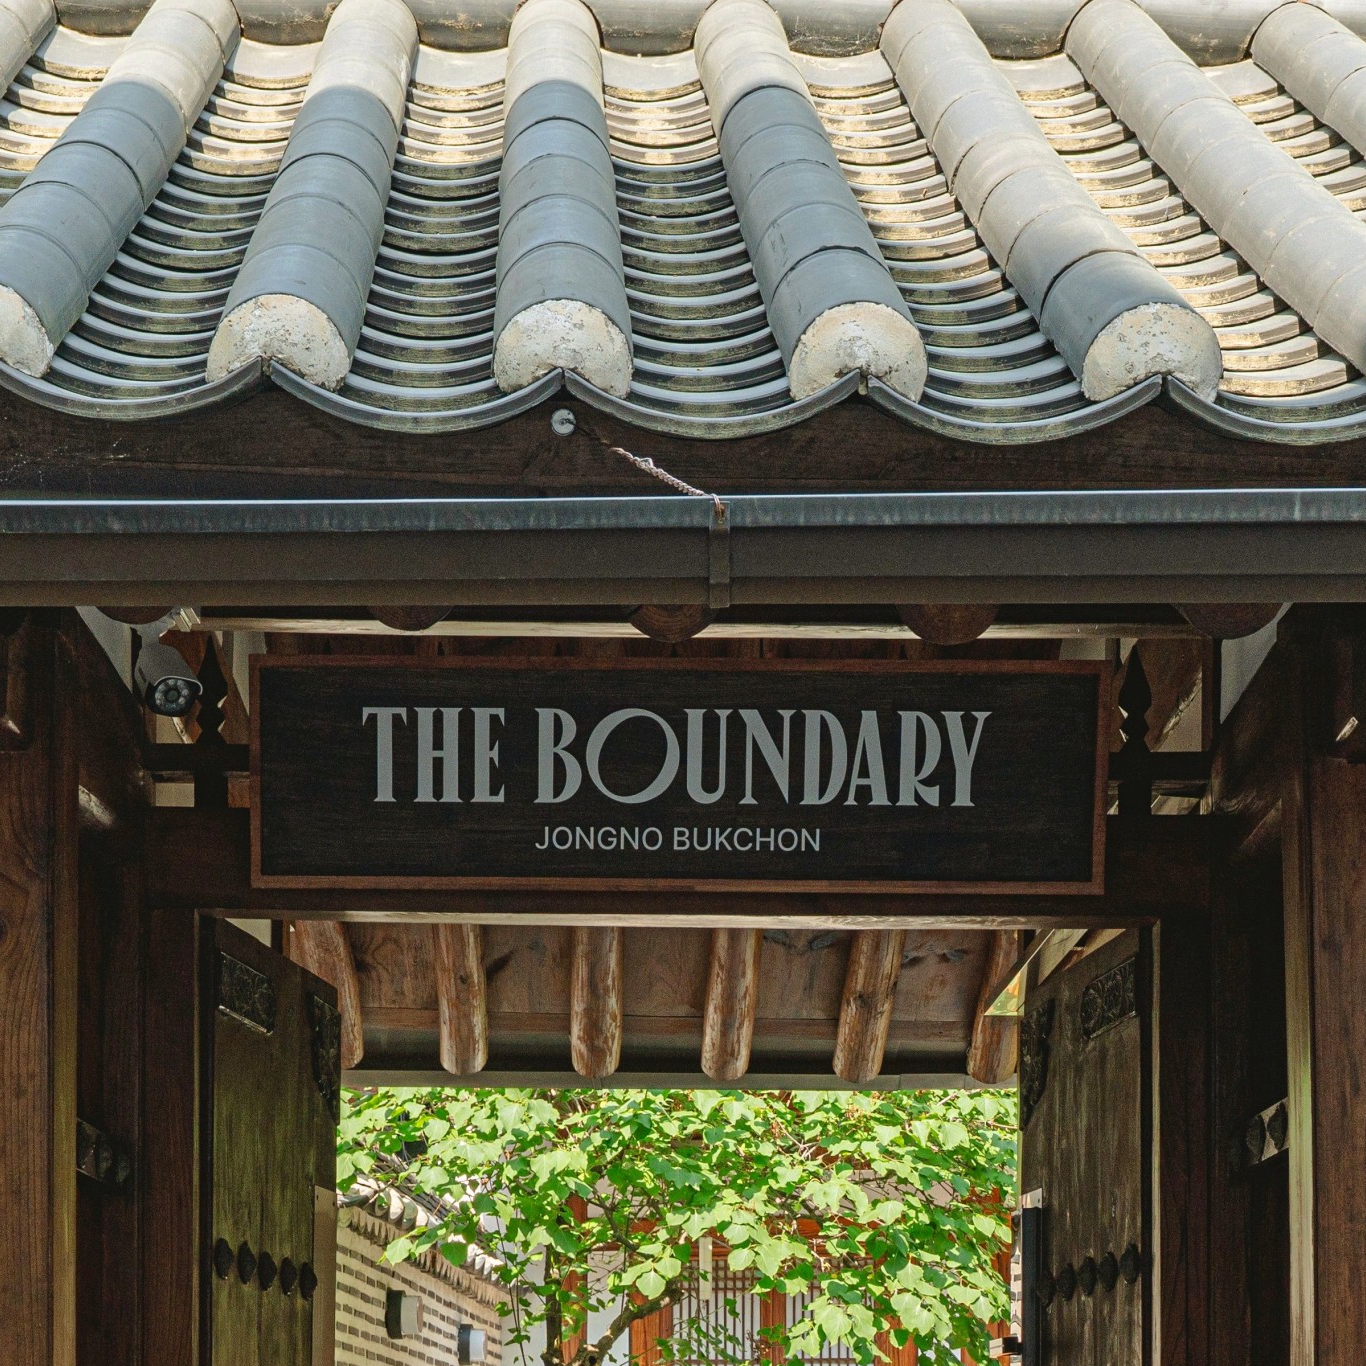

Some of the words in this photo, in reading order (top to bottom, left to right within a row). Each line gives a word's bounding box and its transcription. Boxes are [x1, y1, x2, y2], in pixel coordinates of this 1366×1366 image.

[361, 706, 506, 803] THE
[533, 707, 993, 807] BOUNDARY
[534, 826, 664, 852] JONGNO
[672, 827, 822, 853] BUKCHON
